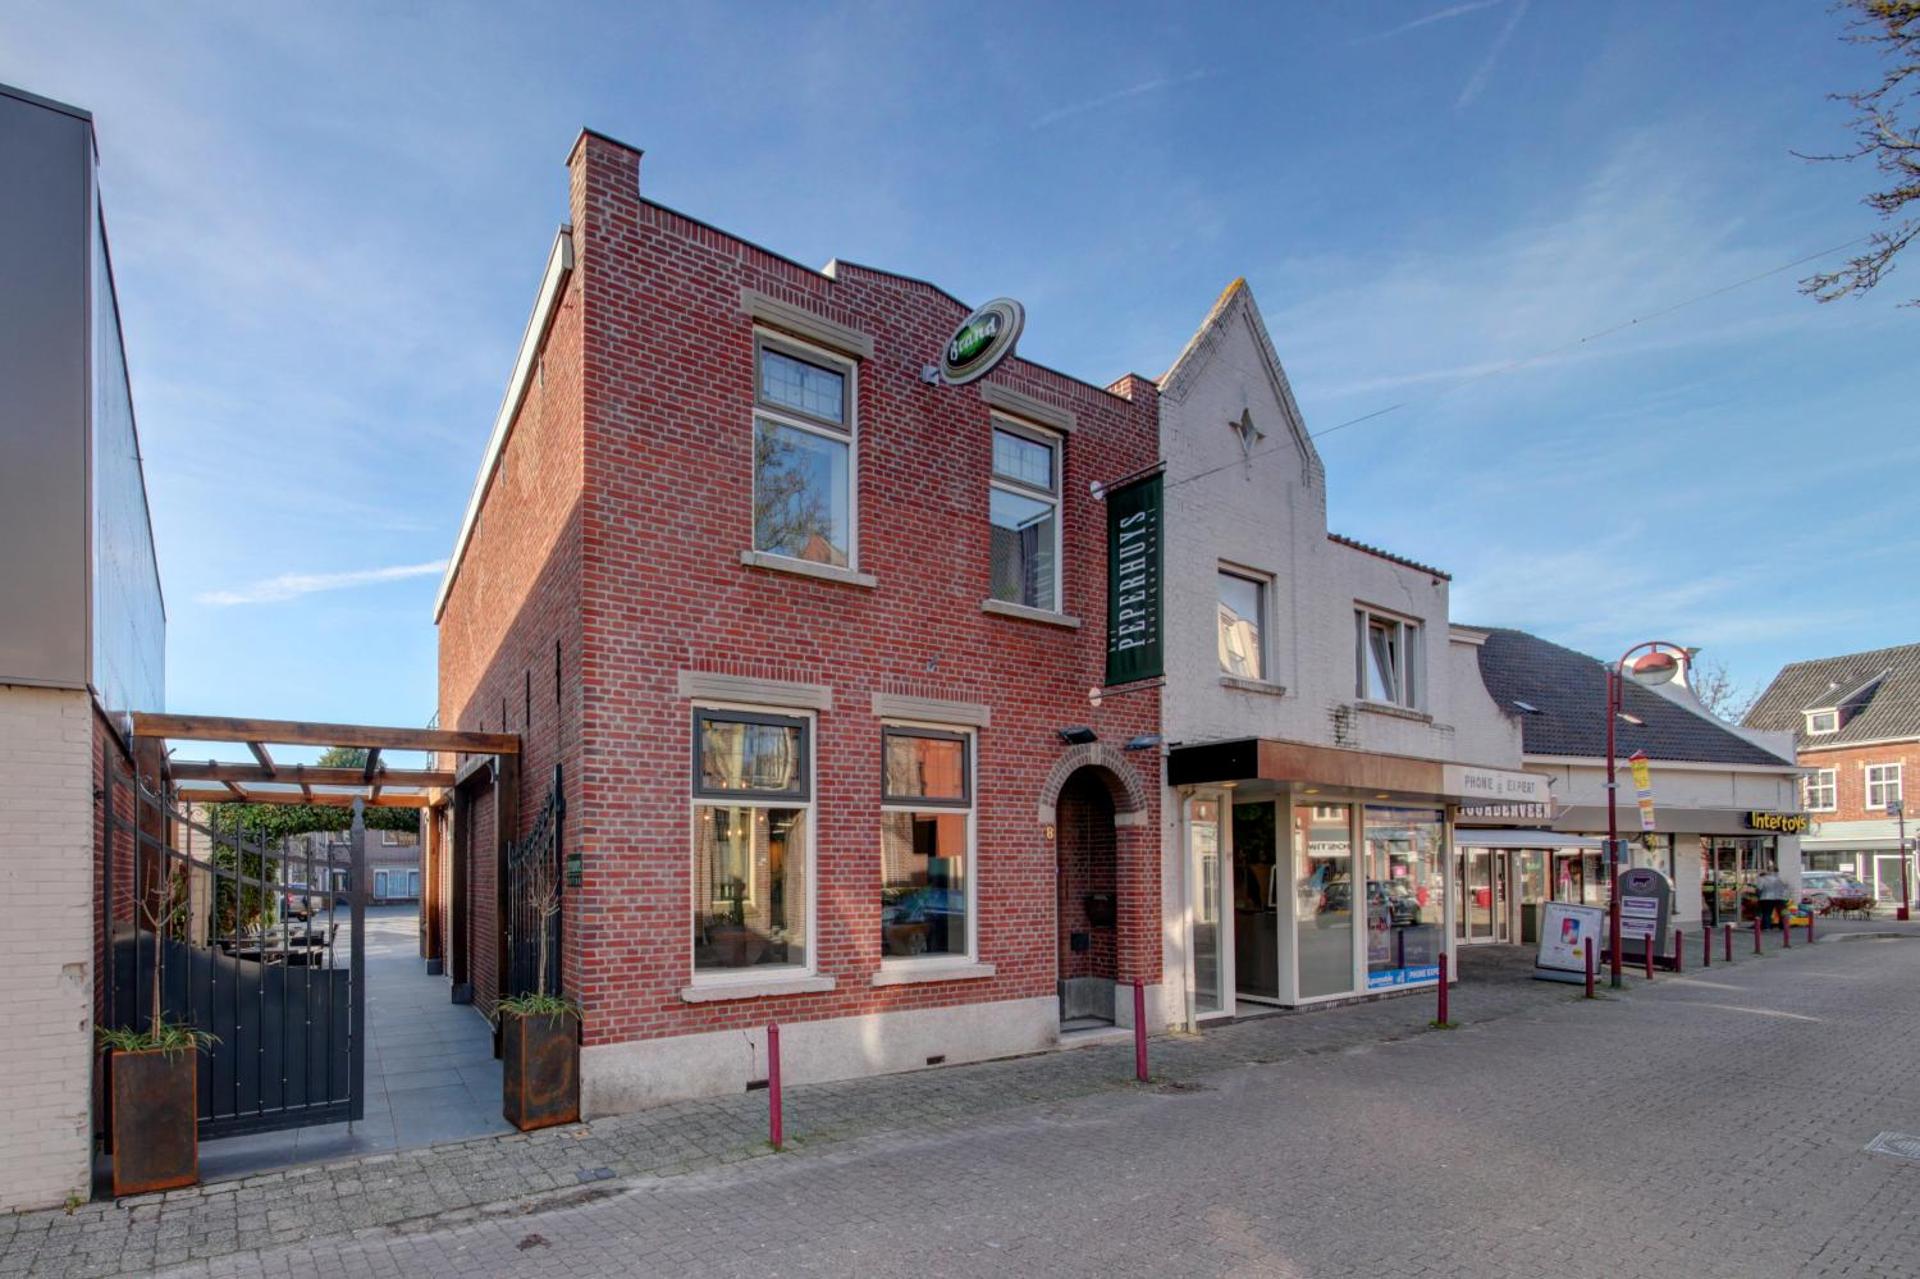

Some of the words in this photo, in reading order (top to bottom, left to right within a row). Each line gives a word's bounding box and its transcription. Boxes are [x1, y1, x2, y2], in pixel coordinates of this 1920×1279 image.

[1118, 511, 1146, 651] PEPERHUYS
[1464, 774, 1494, 790] PHONE
[1507, 780, 1535, 793] EXPERT
[1752, 810, 1806, 831] Intertoys
[1046, 826, 1054, 840] 8
